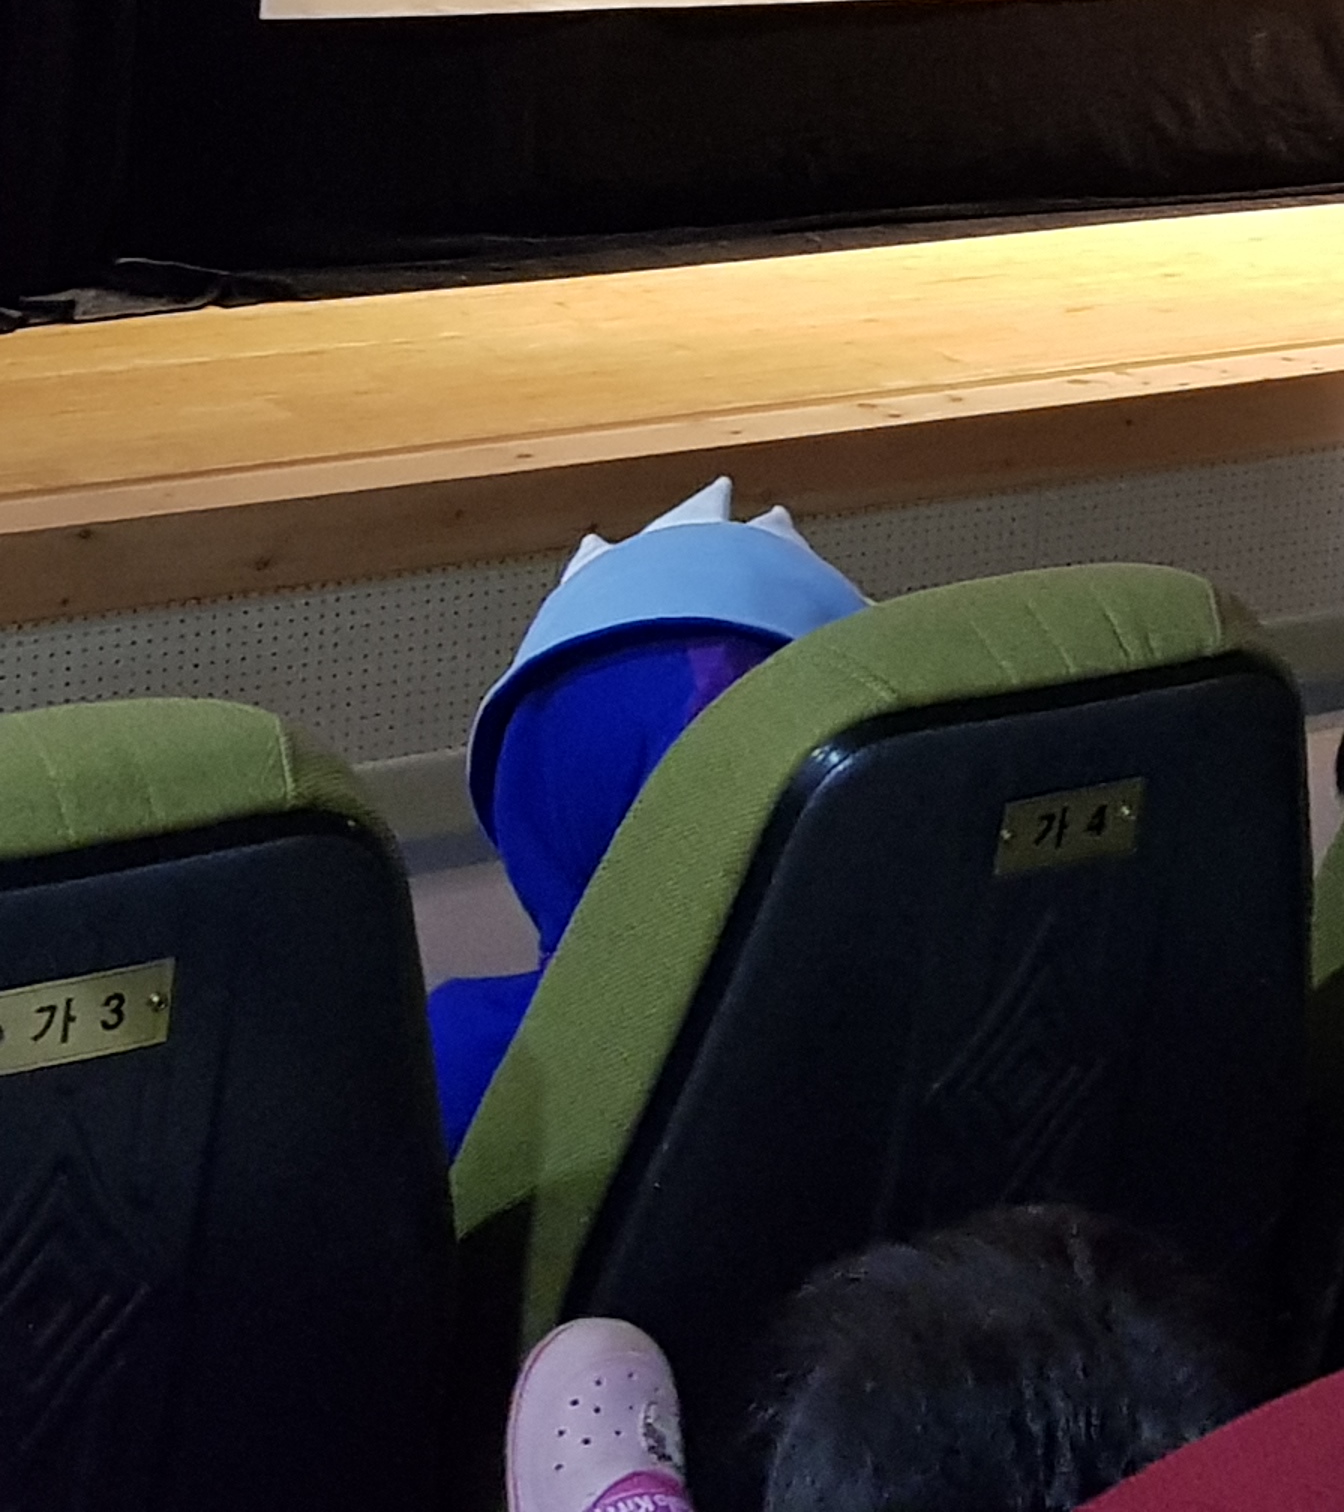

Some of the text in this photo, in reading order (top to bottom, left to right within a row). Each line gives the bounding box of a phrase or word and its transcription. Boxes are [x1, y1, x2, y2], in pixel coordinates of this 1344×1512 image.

[1032, 803, 1108, 850] 가 4
[30, 992, 126, 1044] 가 3
